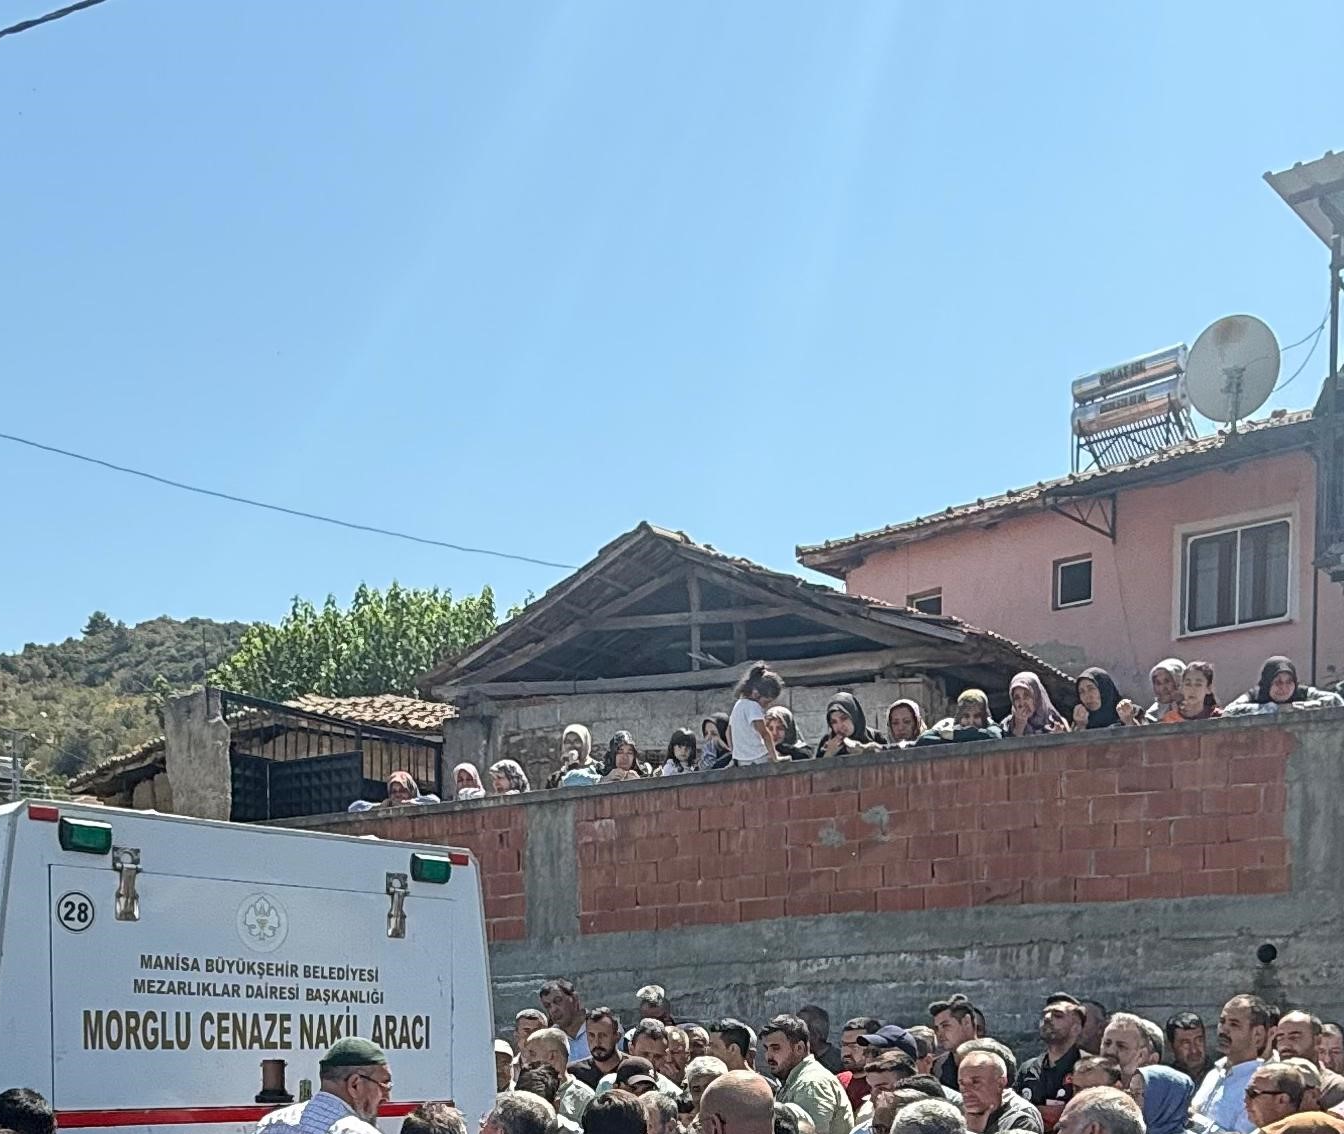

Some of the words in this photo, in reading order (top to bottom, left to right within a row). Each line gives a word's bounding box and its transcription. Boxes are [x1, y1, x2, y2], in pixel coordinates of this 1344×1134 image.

[64, 901, 88, 922] 28
[140, 953, 200, 972] MANİSA
[205, 956, 298, 979] BÜYÜKŞEHİR
[303, 963, 378, 982] BELEDİYESİ
[134, 979, 241, 998] MEZARLIKLAR
[245, 982, 299, 1000] DAİRESİ
[305, 987, 384, 1006] BAŞKANLIĞI
[83, 1010, 191, 1050] MORGLU
[199, 1011, 292, 1050] CENAZE
[371, 1014, 430, 1049] ARACI
